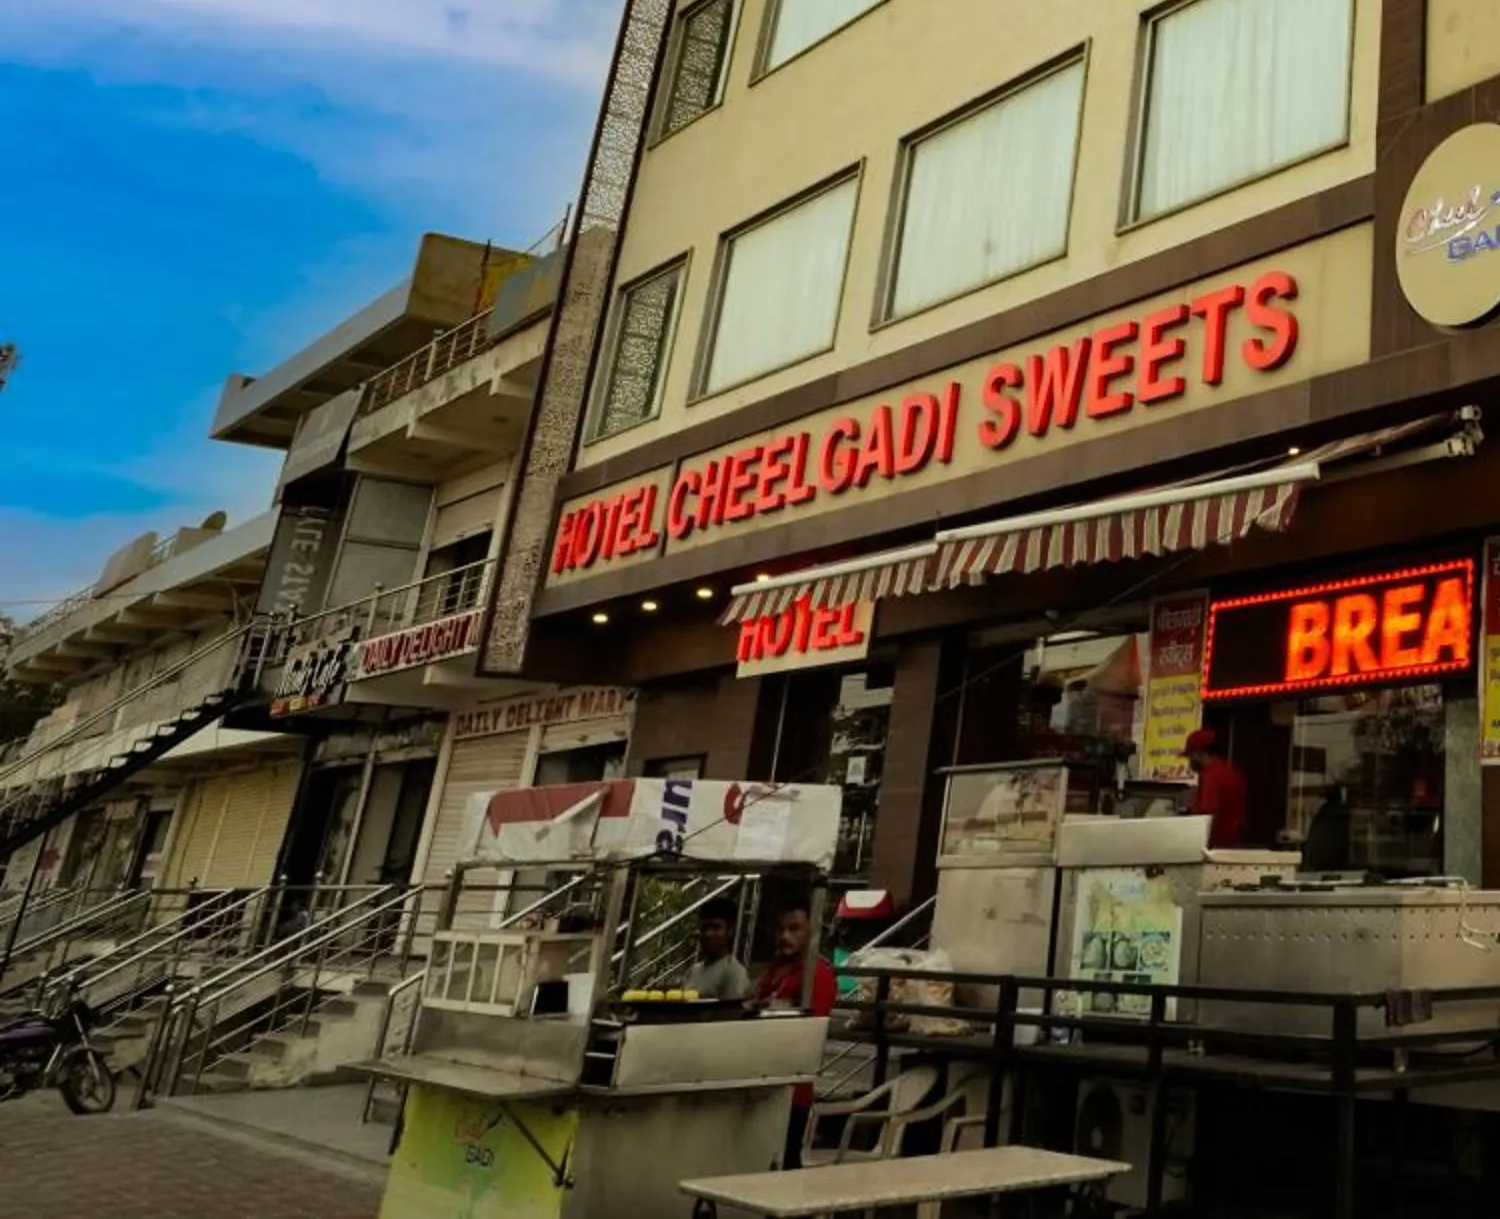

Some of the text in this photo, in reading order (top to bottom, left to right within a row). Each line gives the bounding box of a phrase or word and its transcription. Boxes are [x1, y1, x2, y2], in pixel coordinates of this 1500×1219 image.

[551, 484, 660, 574] HOTEL
[977, 270, 1301, 449] SWEETS
[361, 633, 404, 673] DAILY
[401, 615, 473, 666] DELIGHT
[737, 591, 865, 663] HOTEL
[1284, 577, 1469, 682] BREA
[456, 707, 503, 736] DAILY
